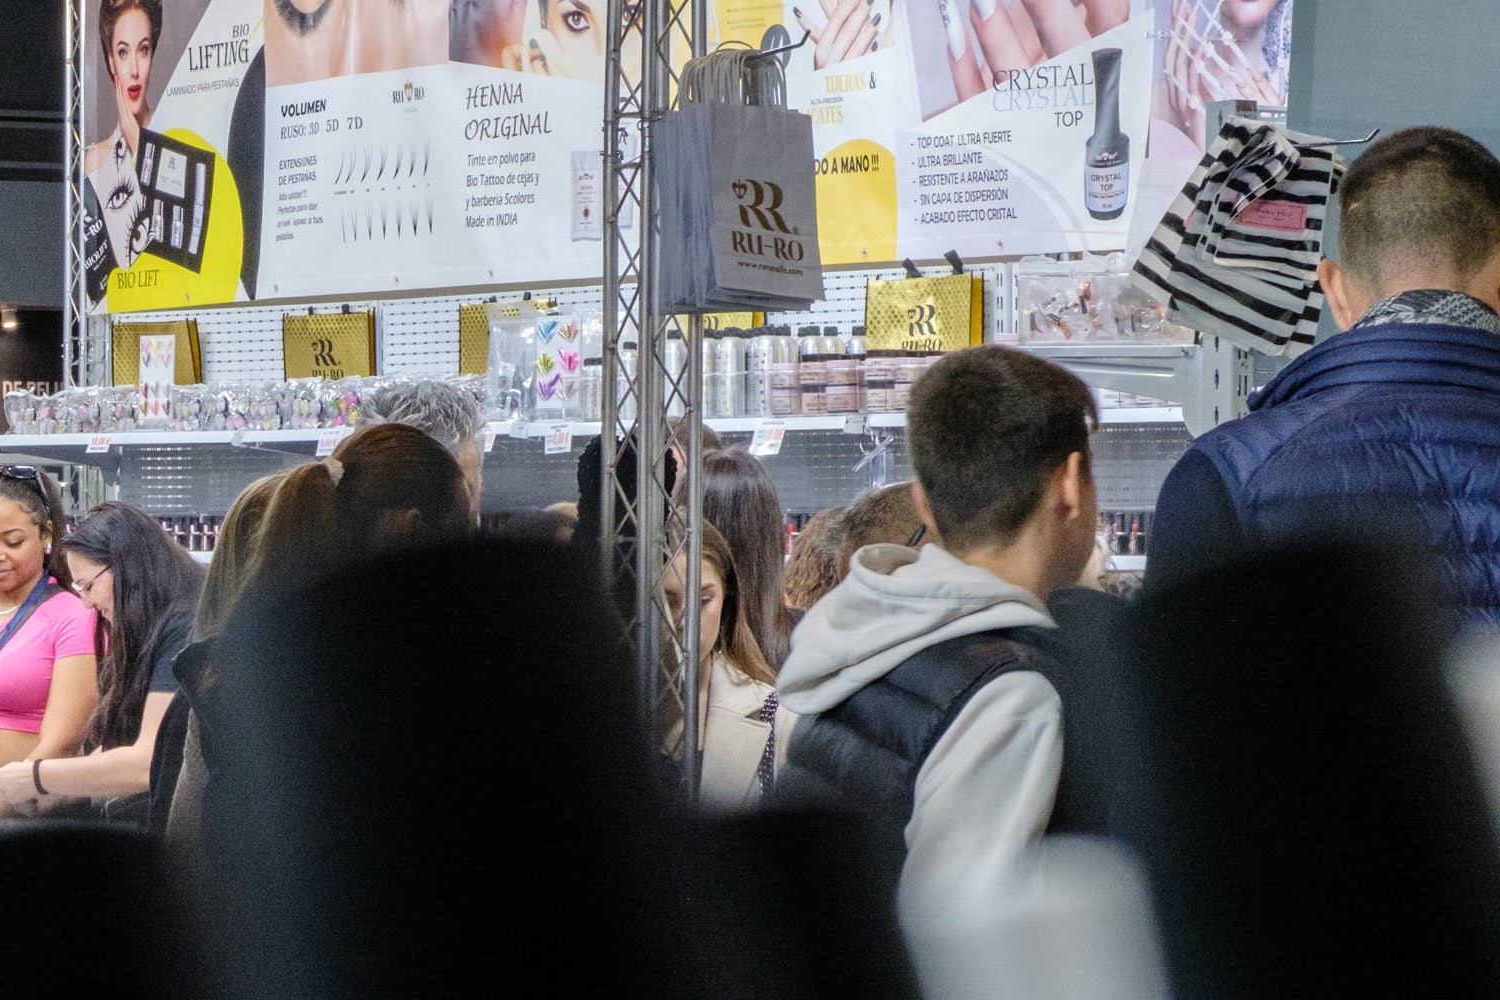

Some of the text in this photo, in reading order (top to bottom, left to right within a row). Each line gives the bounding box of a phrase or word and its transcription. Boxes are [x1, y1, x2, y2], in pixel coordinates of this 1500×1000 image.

[233, 23, 249, 38] BIO
[188, 39, 249, 71] LIFTING
[167, 78, 240, 96] LAMINADO PARA PESTAÑAS
[825, 71, 877, 93] TIJERAS &
[993, 63, 1093, 93] CRYSTAL
[414, 86, 425, 101] RO
[466, 82, 523, 110] HENNA
[281, 99, 327, 118] VOLUMEN
[280, 116, 363, 139] RUSO: 3D 5D 7D
[464, 110, 552, 141] ORIGINAL
[1054, 110, 1083, 127] TOP
[918, 130, 1012, 149] TOP COAT ULTRA FUERTE
[279, 155, 318, 170] EXTENSIONES
[467, 151, 536, 168] Tinte en polvo para
[814, 159, 828, 176] DO
[831, 157, 838, 174] A
[841, 154, 870, 174] MANO
[918, 152, 982, 168] ULTRA BRILLANTE
[278, 170, 316, 186] DE PESTAÑAS
[466, 171, 540, 188] Bio Tattoo de cejas y
[919, 169, 1009, 187] RESISTENTE A ARAÑAZOS
[1091, 172, 1122, 182] CRYSTAL
[920, 186, 1009, 206] SIN CAPA DE DISPERSIÓN
[1100, 183, 1114, 192] TOP
[465, 198, 470, 211] y
[466, 213, 518, 228] Made in INDIA
[920, 207, 1017, 224] ACABADO EFECTO CRISTAL
[84, 238, 109, 270] BIOLIFT
[731, 230, 804, 262] RU-RO
[117, 271, 136, 290] BIO
[138, 269, 160, 288] LIFT
